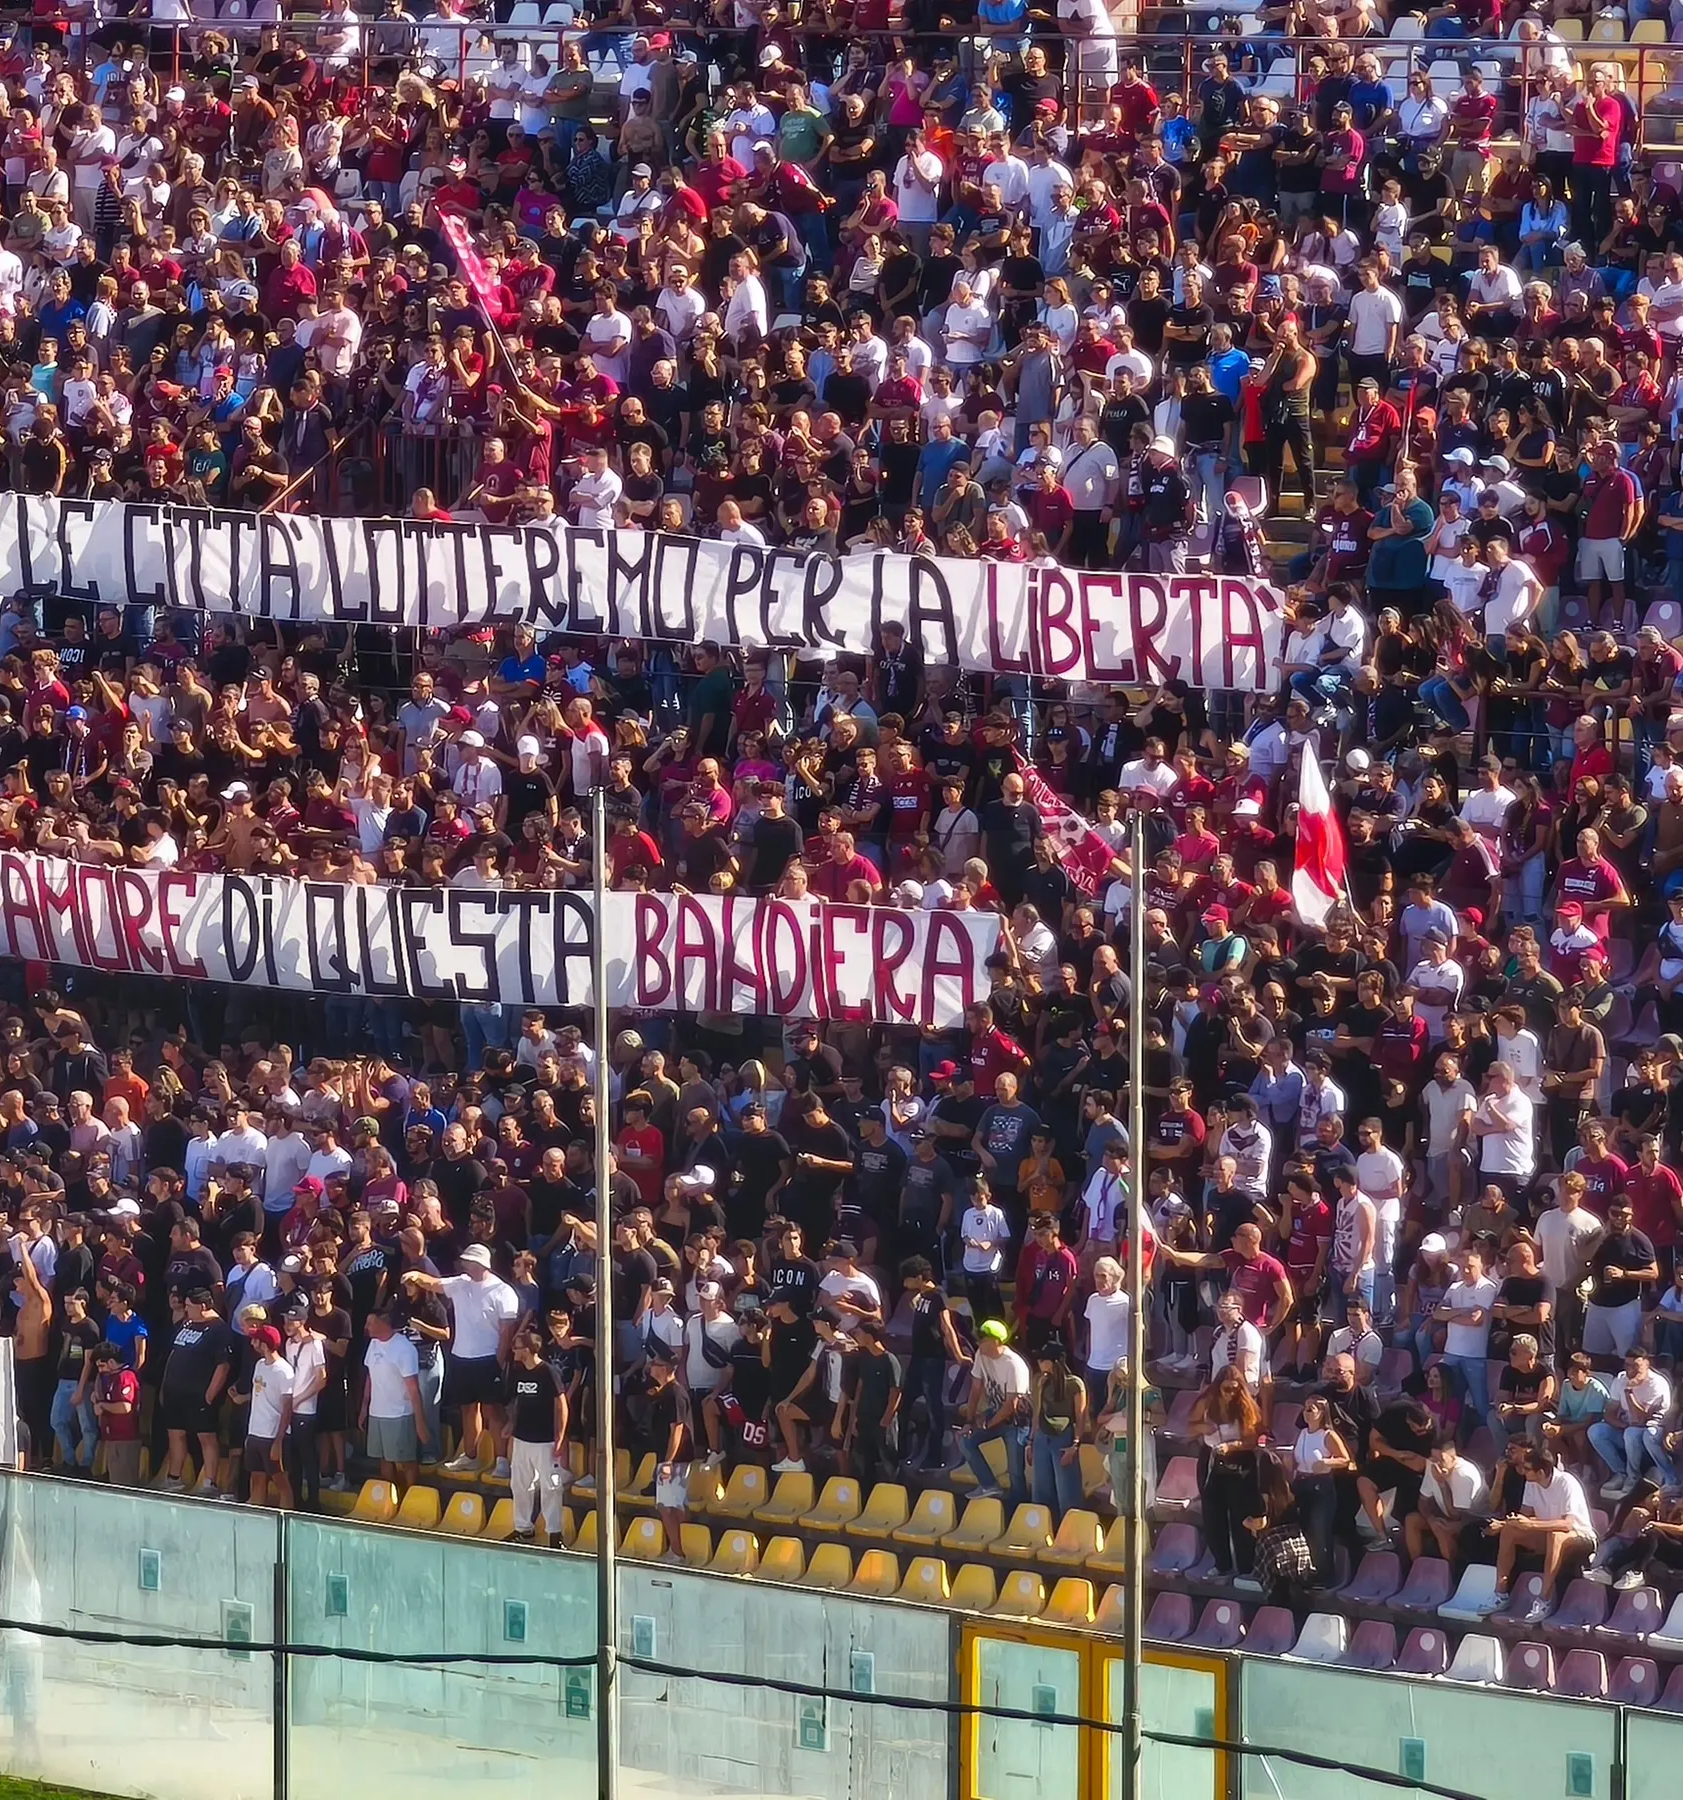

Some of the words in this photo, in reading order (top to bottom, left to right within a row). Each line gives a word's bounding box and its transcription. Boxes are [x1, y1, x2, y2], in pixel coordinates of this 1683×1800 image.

[18, 499, 99, 600] LE
[321, 519, 701, 641] LOTTEREMO
[726, 546, 847, 651] PER
[1, 852, 208, 979] AMORE
[306, 882, 595, 1005] QUESTA
[772, 1269, 805, 1286] ICON
